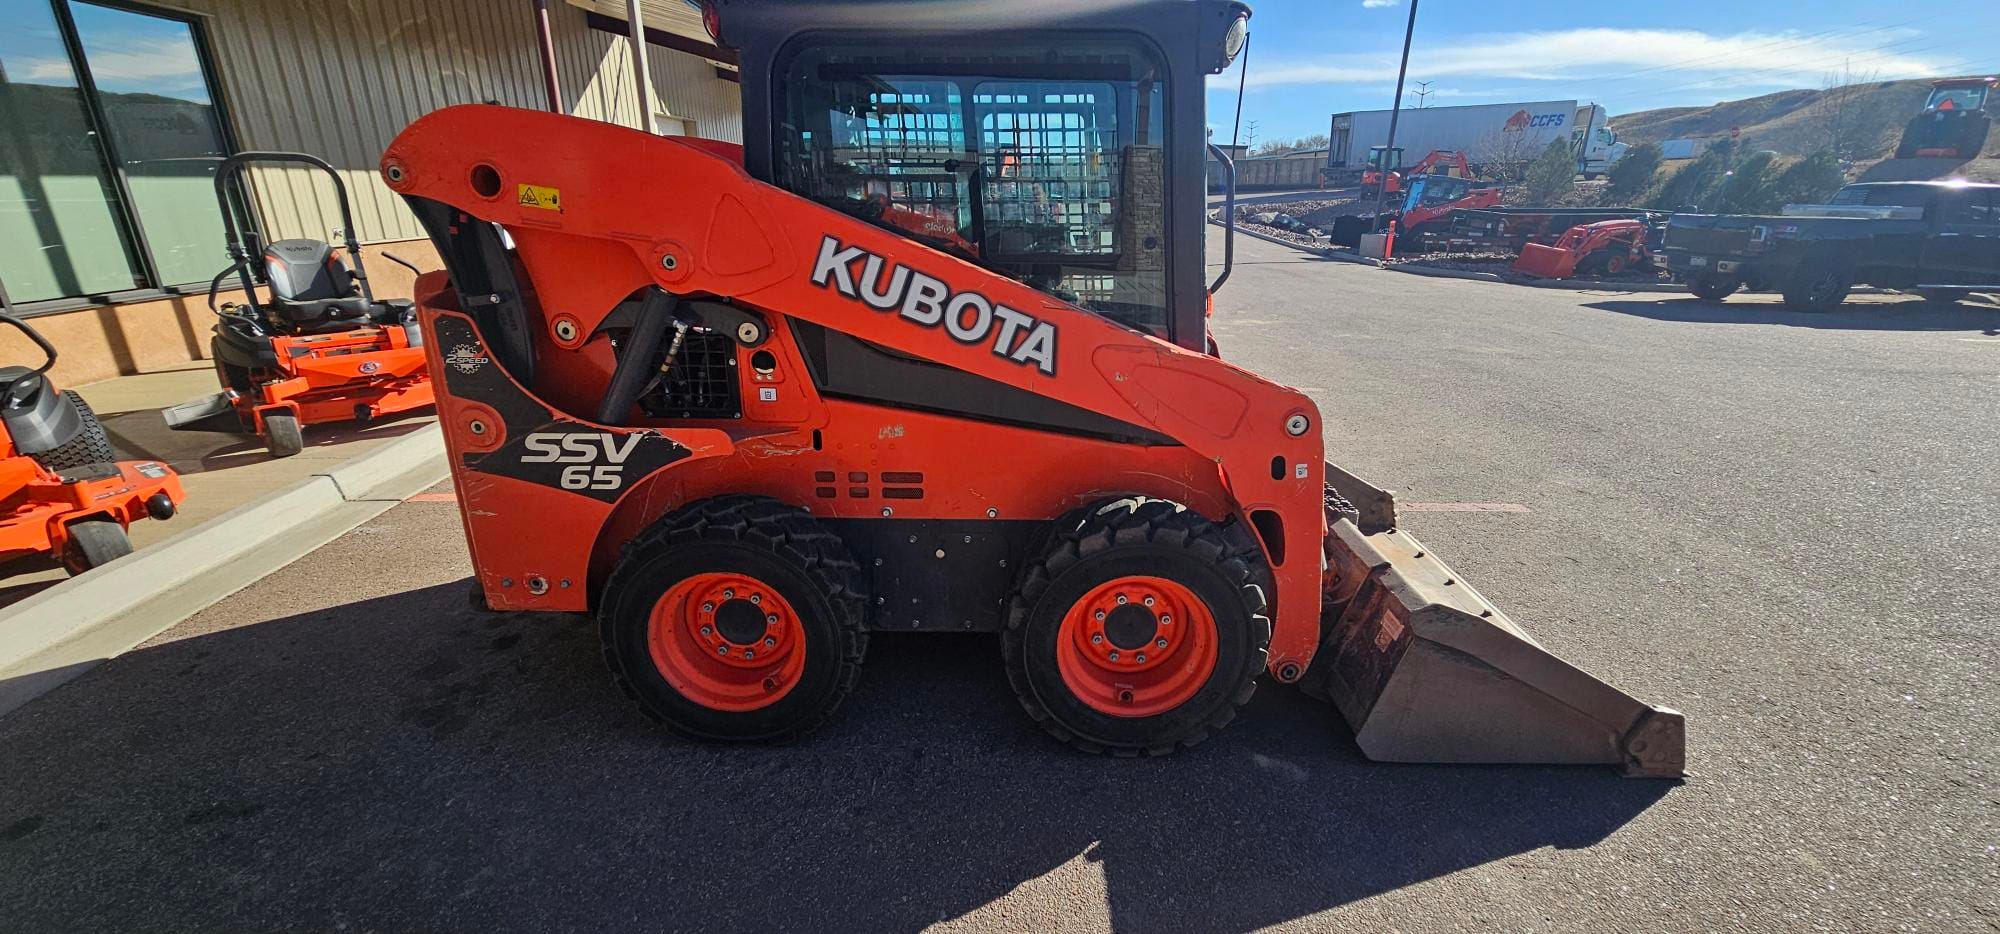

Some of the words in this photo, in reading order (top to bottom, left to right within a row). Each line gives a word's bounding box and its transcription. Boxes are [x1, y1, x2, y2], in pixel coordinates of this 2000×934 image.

[1530, 113, 1565, 127] CCFS
[811, 235, 1056, 375] KUBOTA
[521, 432, 643, 463] SSV
[560, 465, 623, 489] 65
